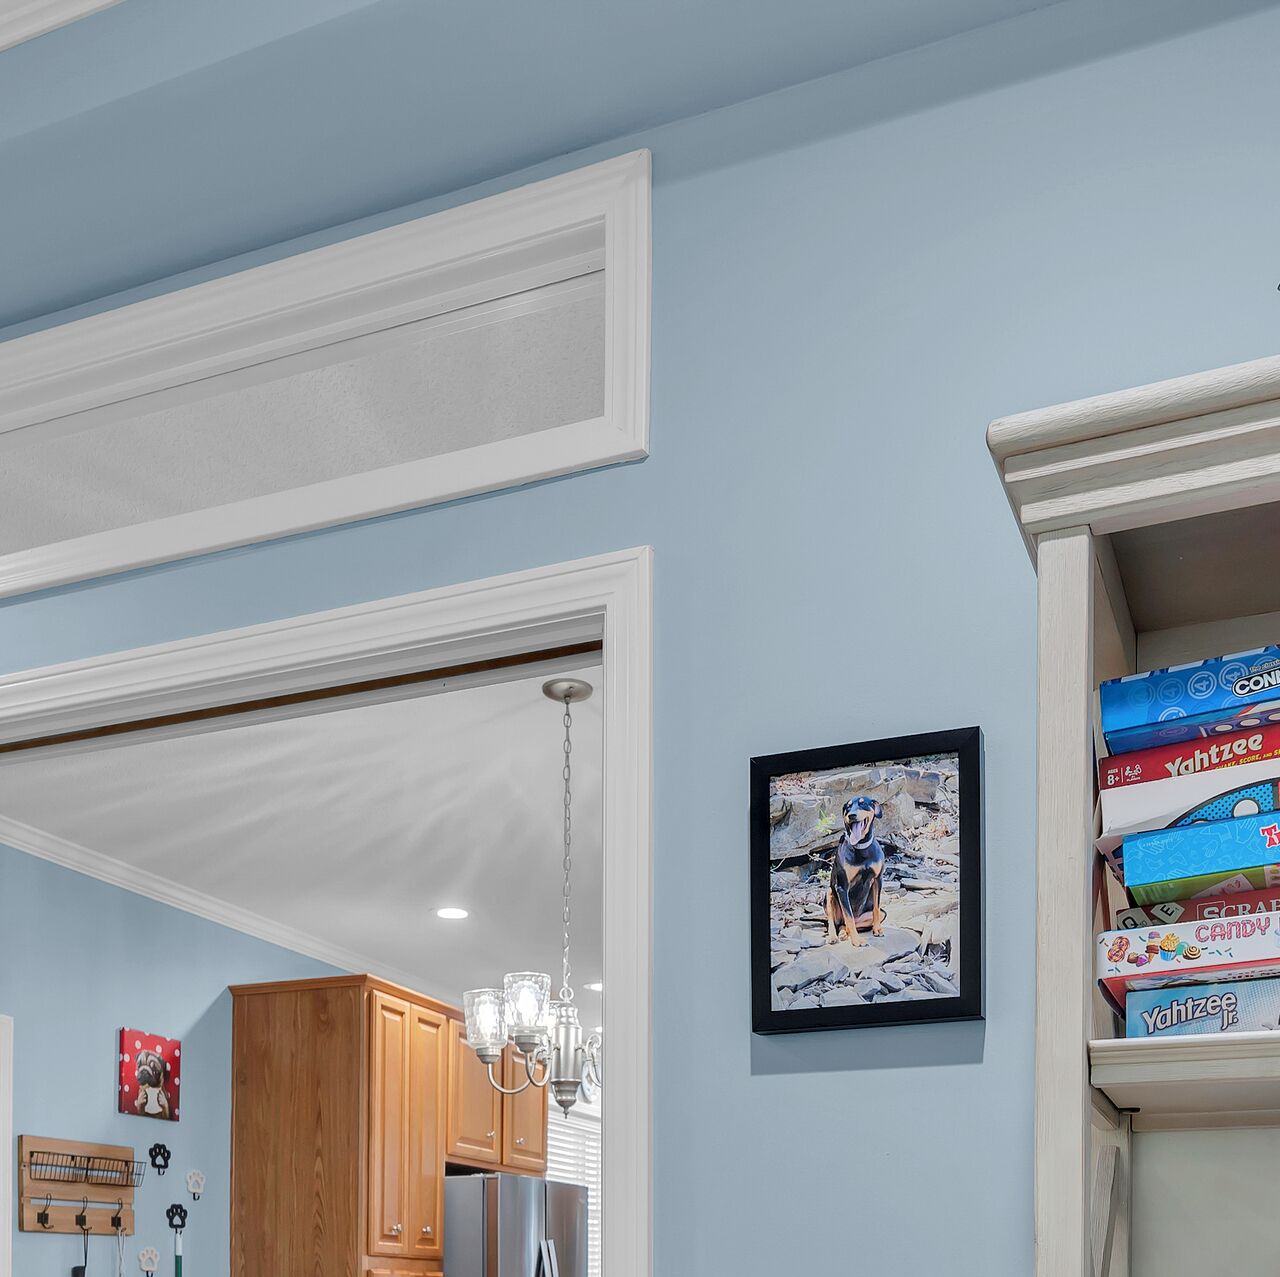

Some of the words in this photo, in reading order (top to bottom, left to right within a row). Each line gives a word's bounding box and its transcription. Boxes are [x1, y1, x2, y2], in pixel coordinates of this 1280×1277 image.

[1164, 734, 1263, 777] Yahtzee
[1107, 774, 1120, 786] 8+
[1195, 915, 1271, 942] CANDY
[1142, 991, 1238, 1034] Yahtzee
